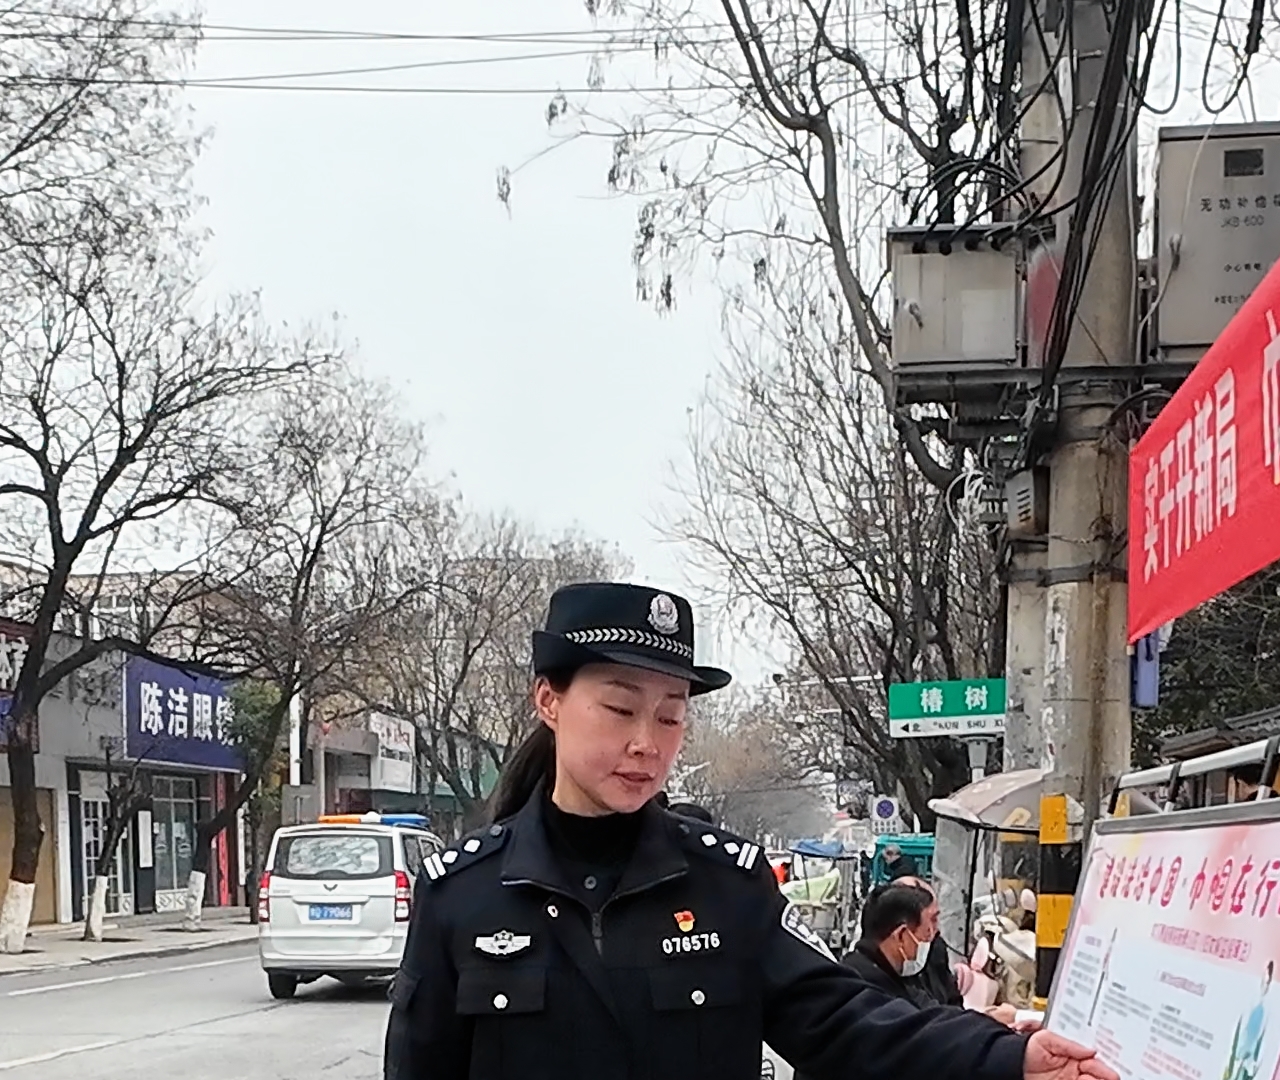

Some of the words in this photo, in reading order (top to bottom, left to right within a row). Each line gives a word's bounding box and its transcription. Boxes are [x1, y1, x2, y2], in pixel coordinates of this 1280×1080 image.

[1144, 367, 1237, 584] 实干开新局
[663, 931, 720, 954] 076576
